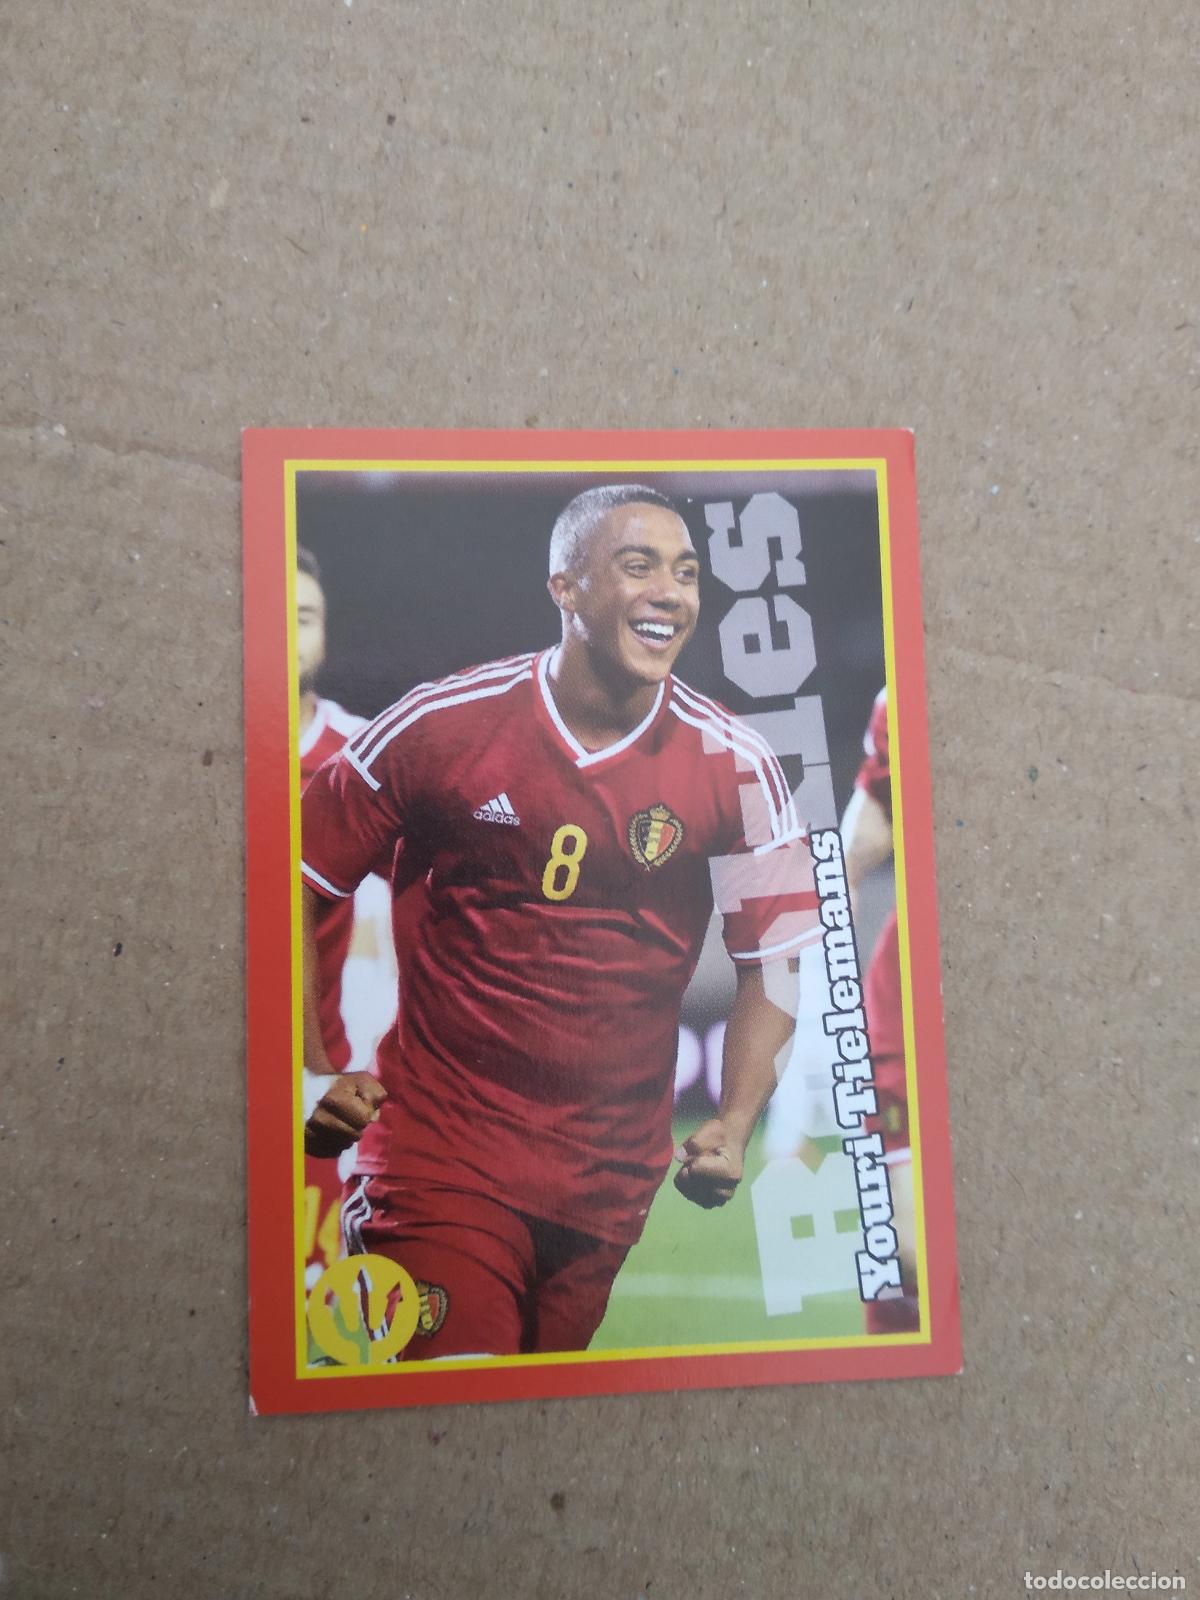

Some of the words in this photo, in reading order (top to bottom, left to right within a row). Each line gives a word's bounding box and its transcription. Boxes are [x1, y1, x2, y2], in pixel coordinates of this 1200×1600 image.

[472, 809, 521, 826] adidas
[541, 823, 588, 901] 8
[808, 827, 879, 1131] Tielemans
[843, 1133, 904, 1303] Youri
